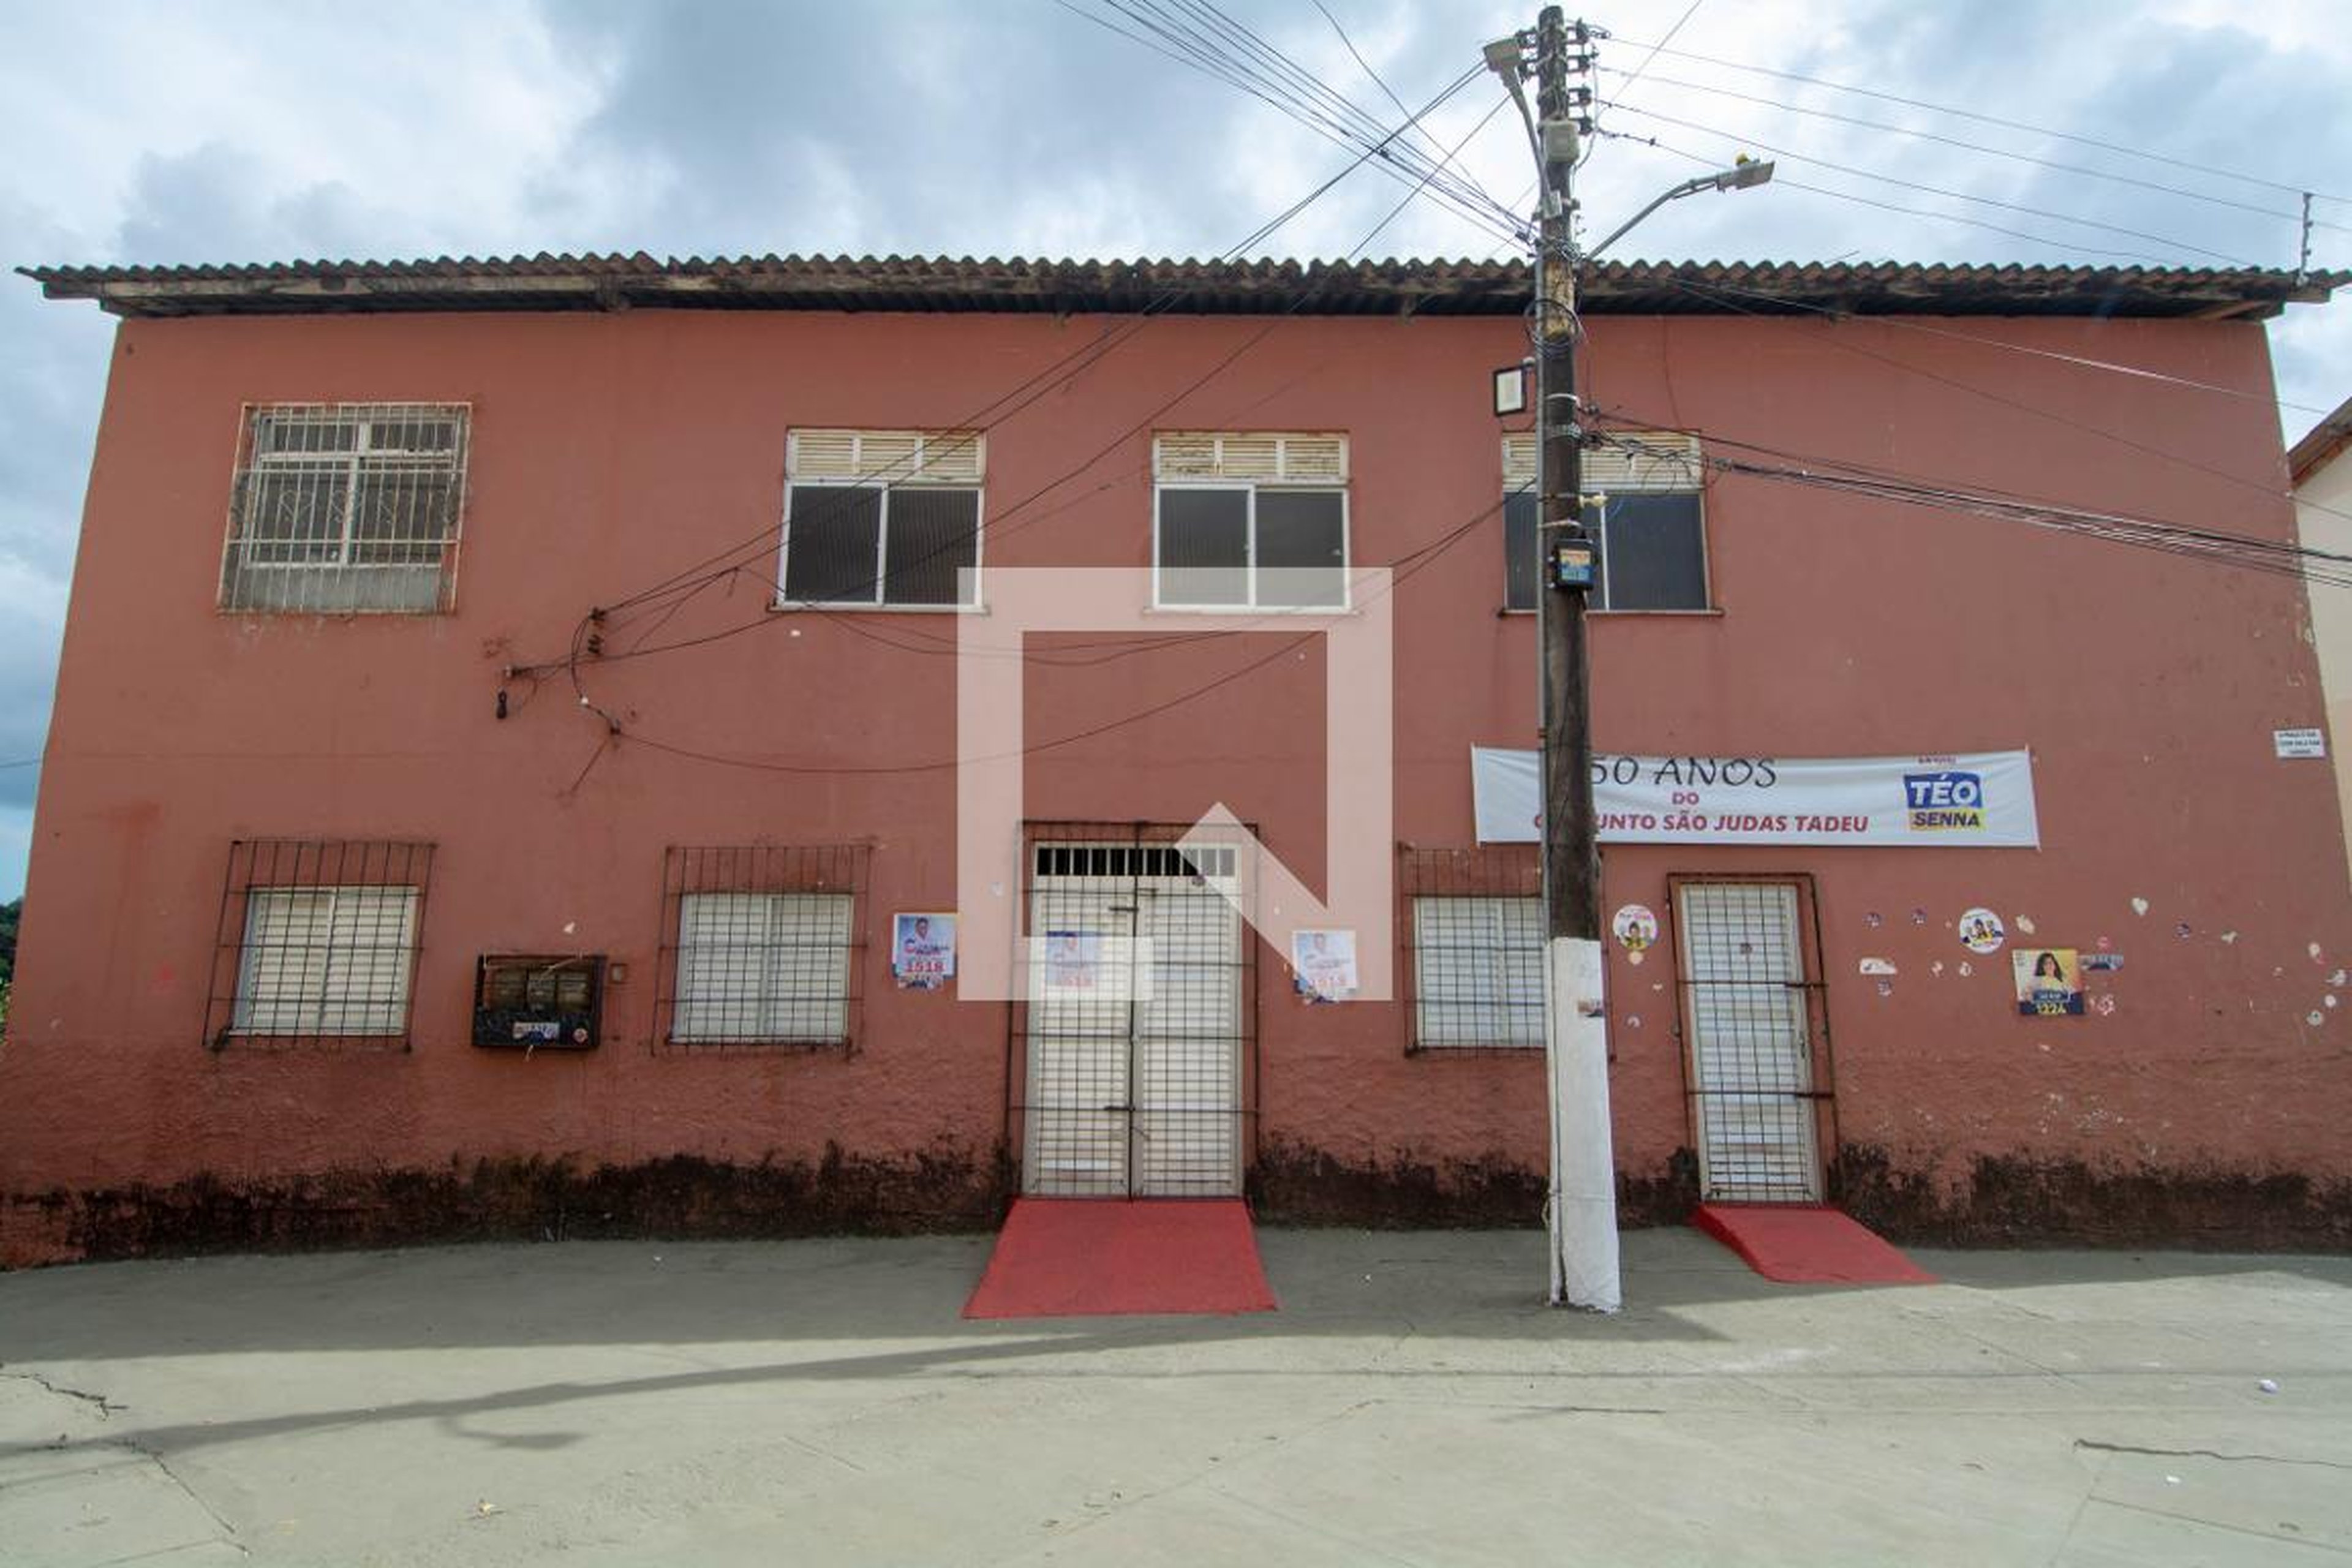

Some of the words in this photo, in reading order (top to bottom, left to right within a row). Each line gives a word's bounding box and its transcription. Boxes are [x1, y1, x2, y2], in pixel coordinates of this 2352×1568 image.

[1592, 755, 1639, 785] 50
[1654, 755, 1776, 788] ANOS
[1672, 792, 1699, 805] DO
[1910, 774, 1977, 806] TÉO
[1663, 810, 1707, 831] SÃO
[1715, 815, 1787, 831] JUDAS
[1795, 816, 1869, 832] TADEU
[1913, 812, 1979, 826] SENNA
